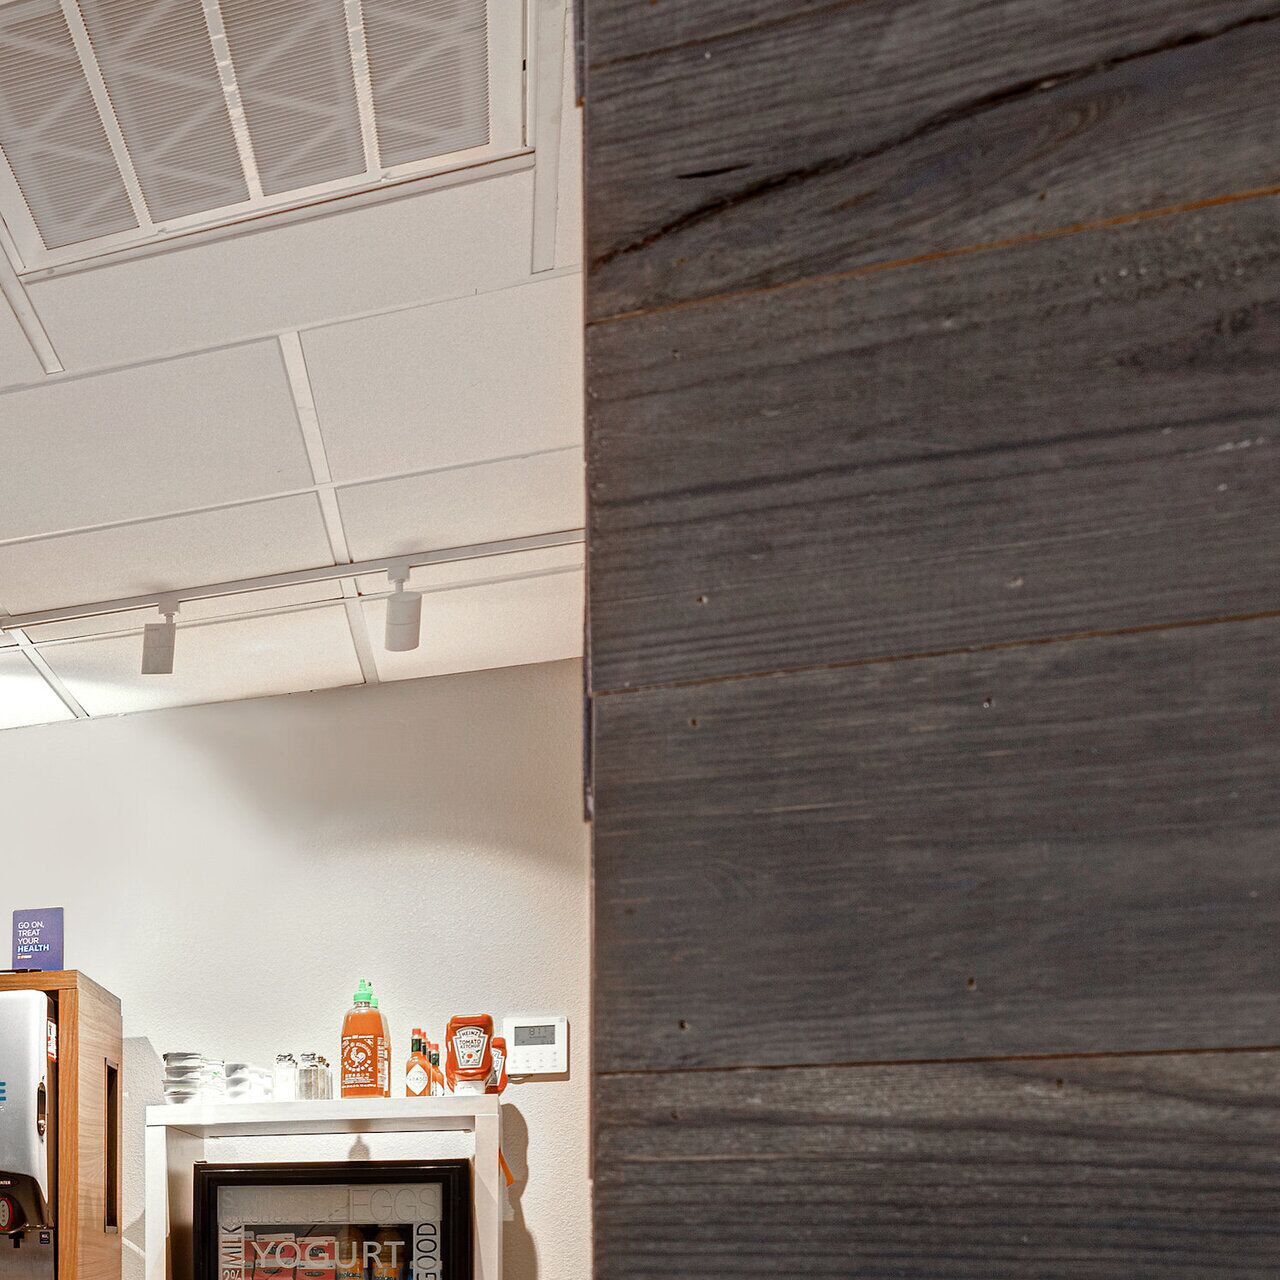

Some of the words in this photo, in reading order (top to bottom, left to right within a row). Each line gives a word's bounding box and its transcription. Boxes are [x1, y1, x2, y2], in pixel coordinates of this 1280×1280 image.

[17, 921, 30, 929] GO
[18, 929, 41, 937] TREAT
[18, 937, 40, 945] YOUR
[17, 944, 50, 953] HEALTH
[352, 1188, 439, 1222] EGGS
[222, 1224, 242, 1267] MILK
[251, 1241, 406, 1269] YOGURT
